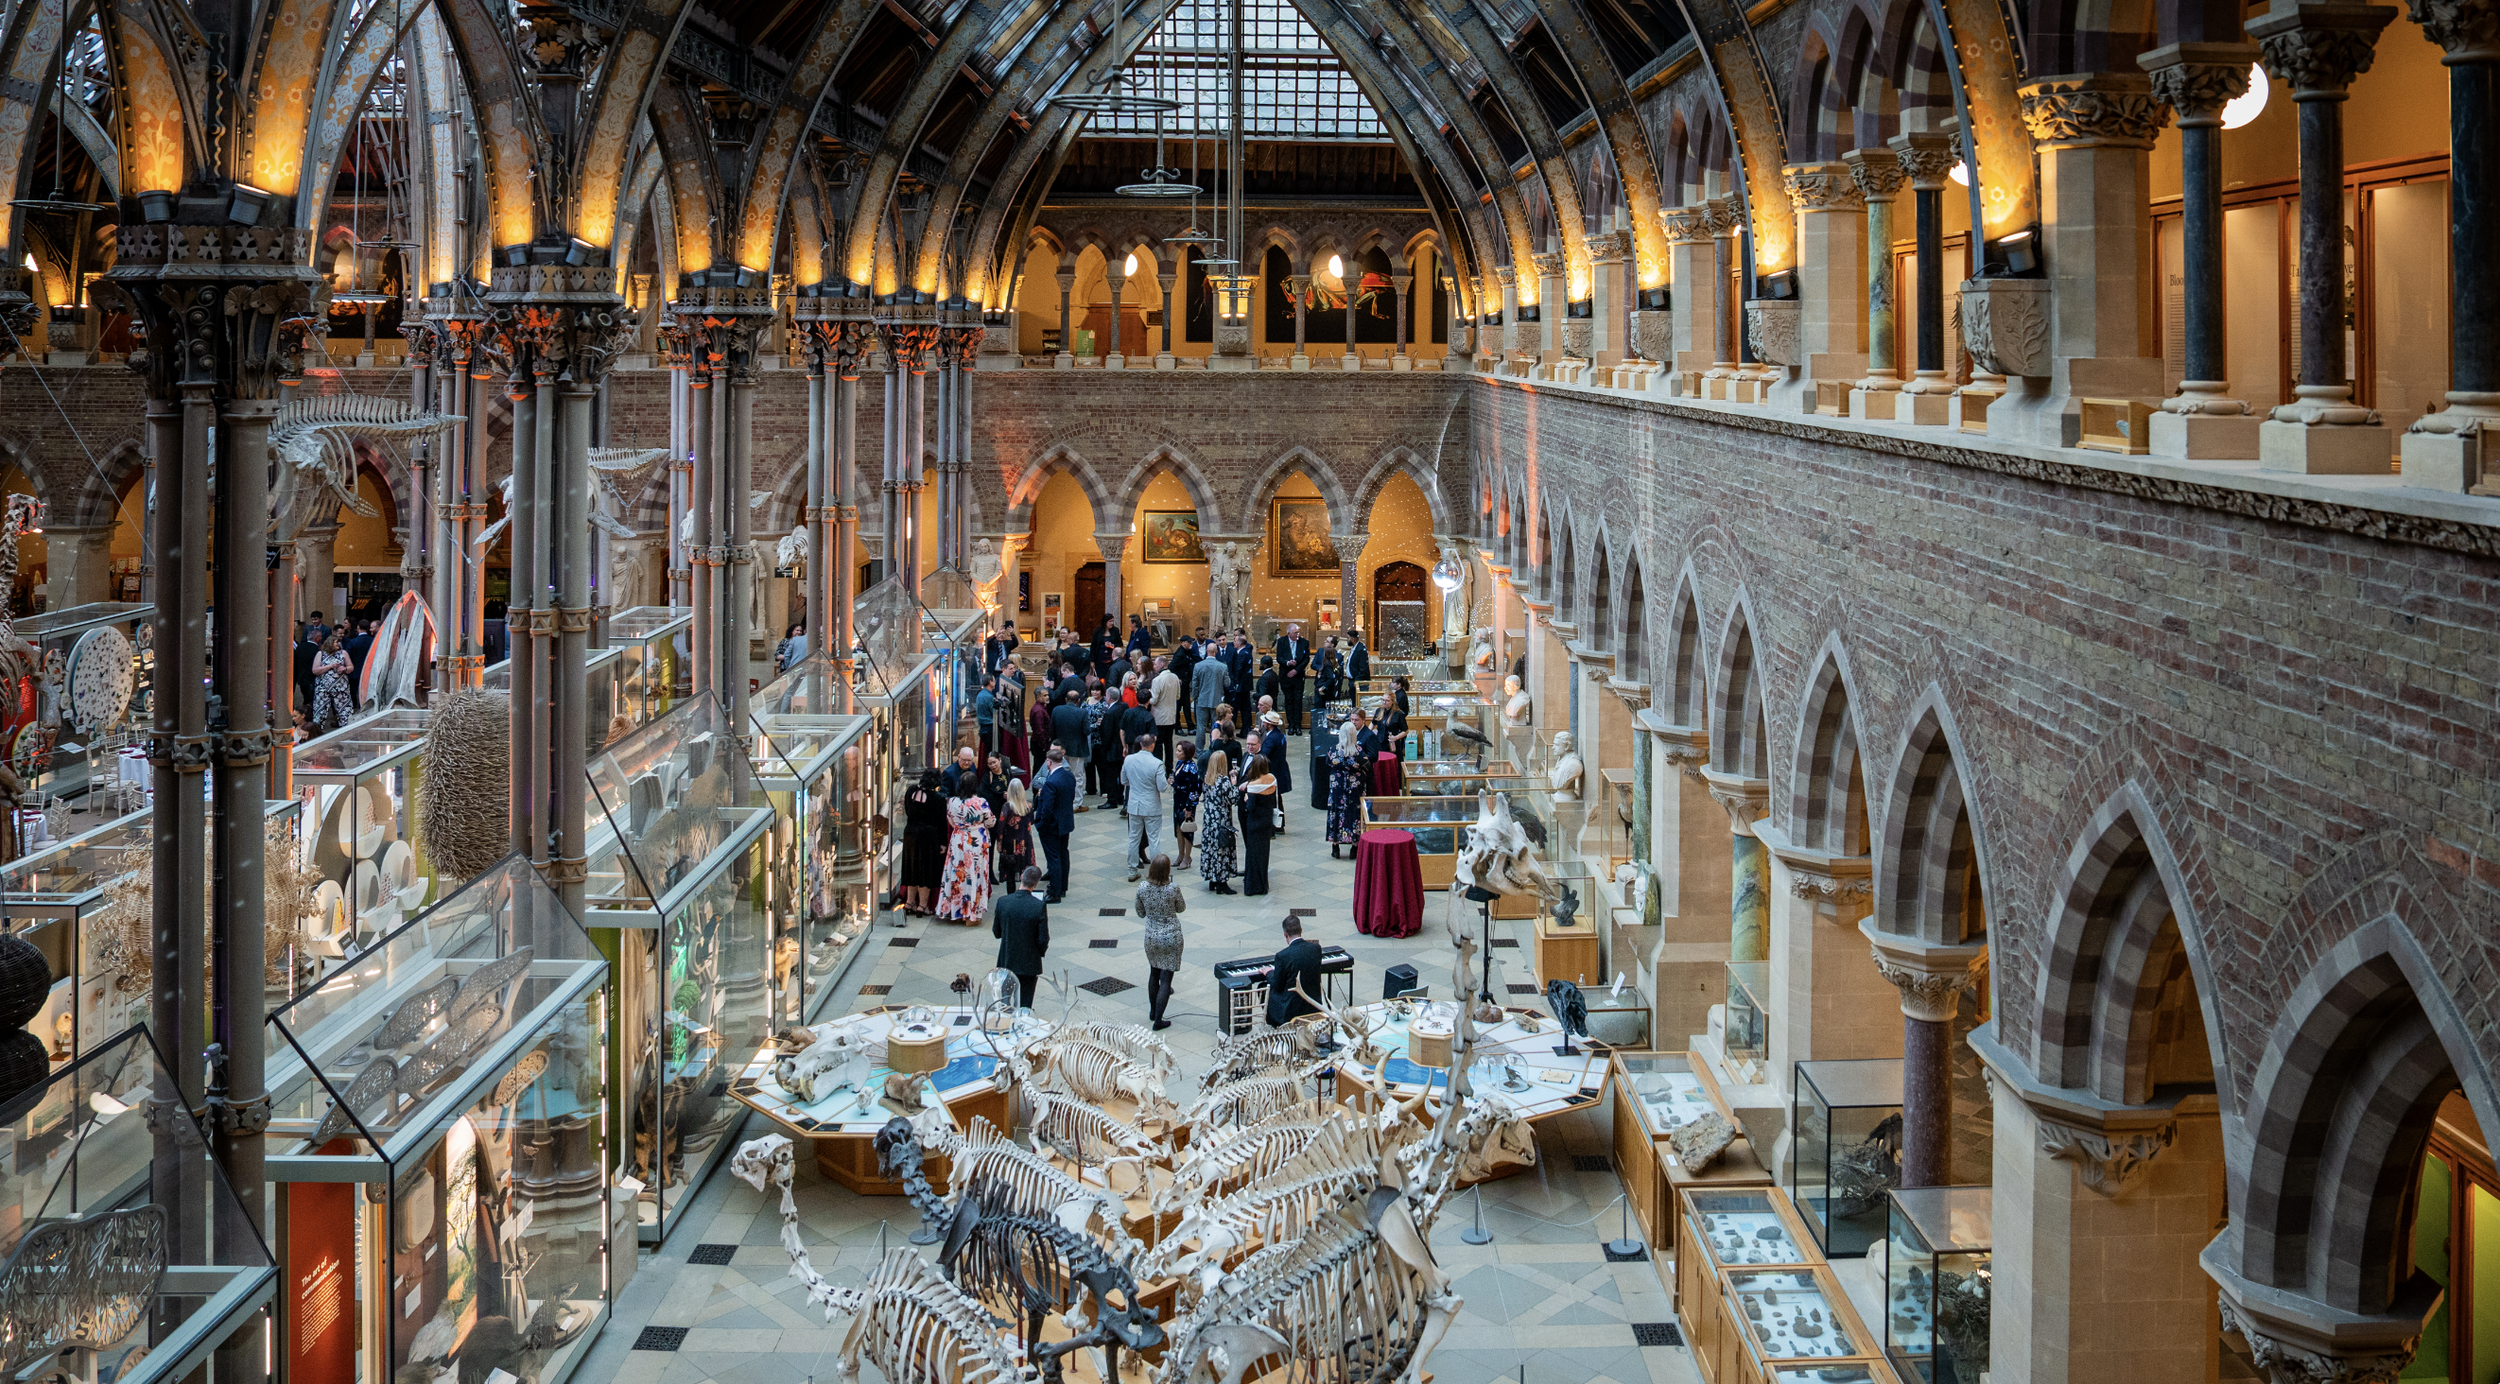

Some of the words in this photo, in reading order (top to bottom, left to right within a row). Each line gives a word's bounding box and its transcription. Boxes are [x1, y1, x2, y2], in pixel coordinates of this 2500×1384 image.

[302, 1275, 311, 1287] The
[312, 1265, 320, 1277] art
[321, 1256, 327, 1269] of
[302, 1259, 339, 1299] communication
